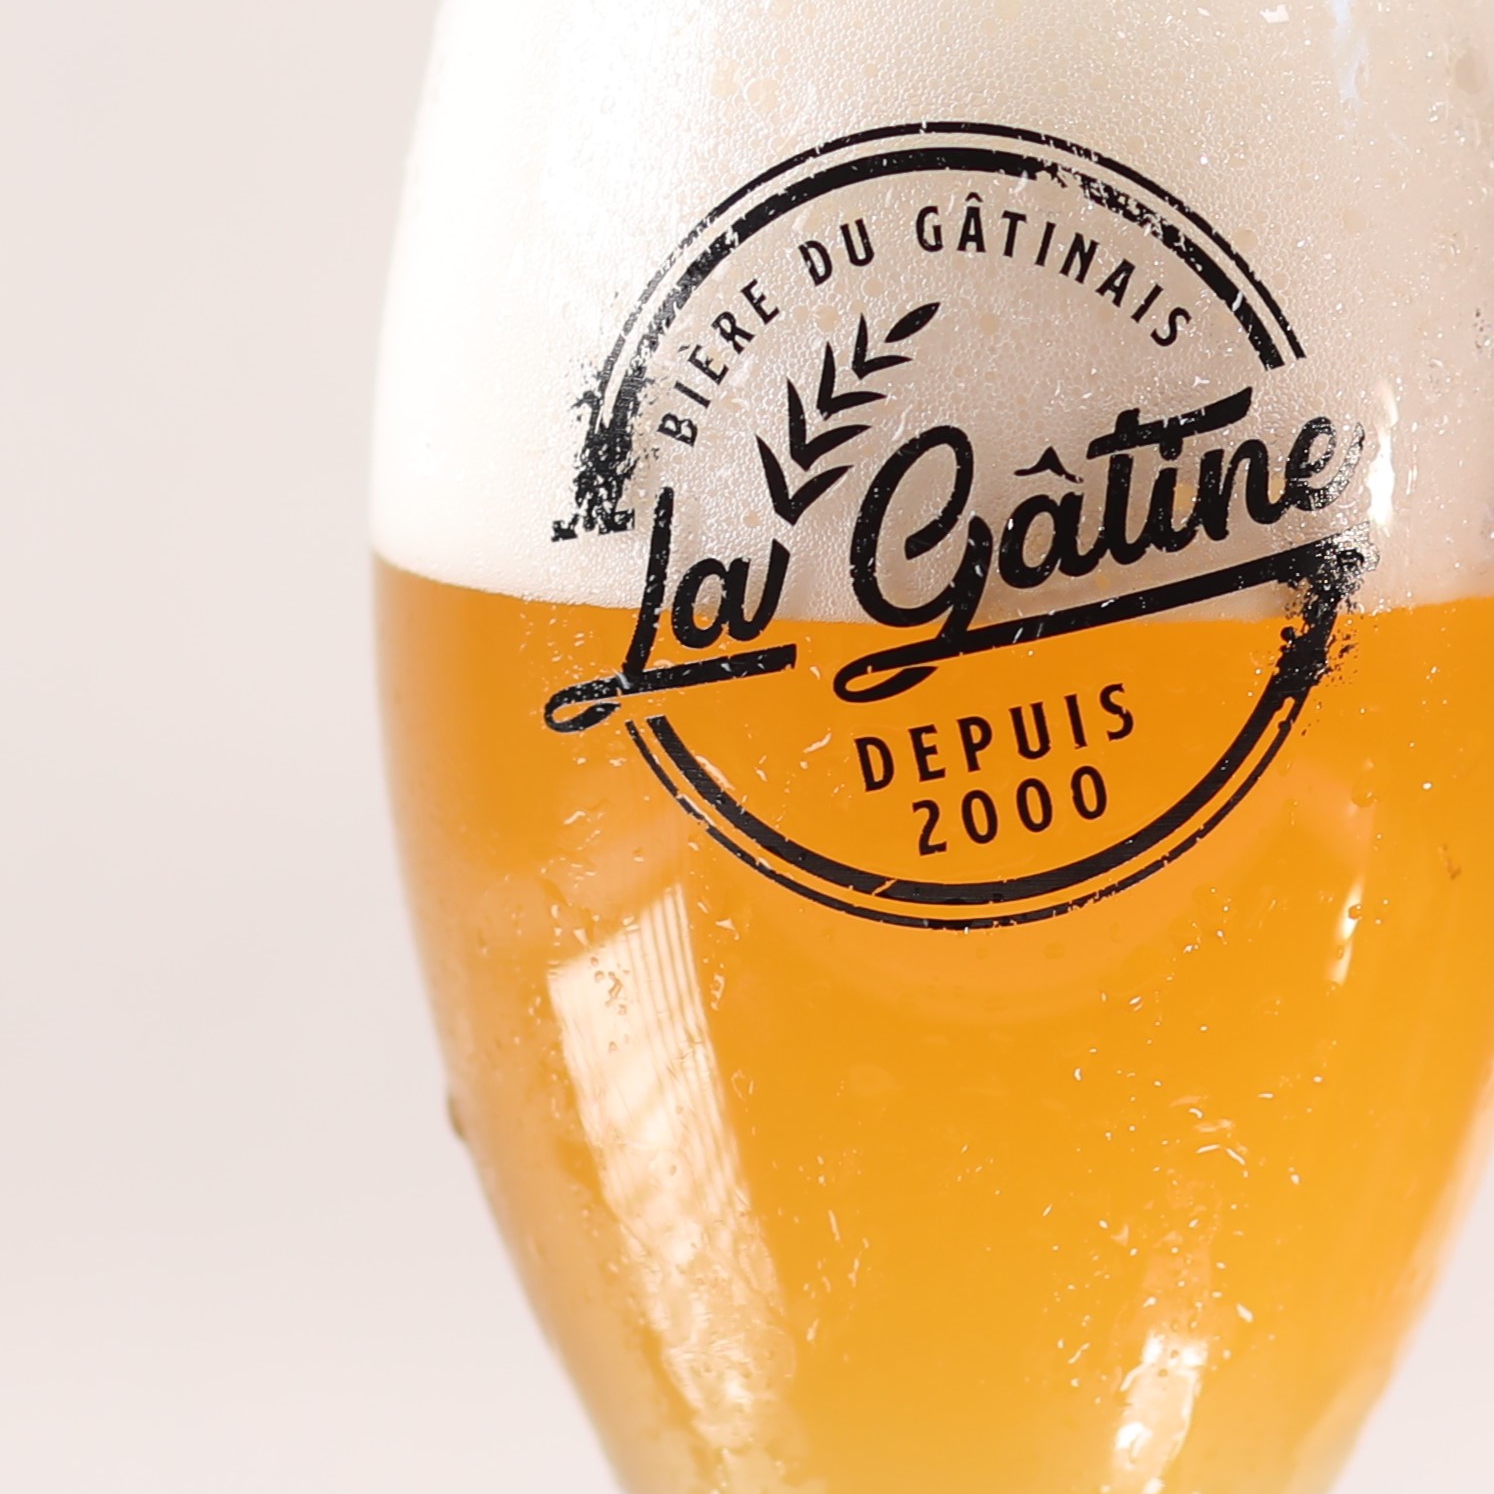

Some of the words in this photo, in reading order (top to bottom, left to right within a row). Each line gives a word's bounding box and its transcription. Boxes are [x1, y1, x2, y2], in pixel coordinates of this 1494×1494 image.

[657, 279, 780, 447] BIÈRE
[799, 218, 876, 287] DU
[916, 193, 1192, 347] GÂTINAIS
[544, 486, 797, 733] La
[833, 387, 1372, 704] Gâtine
[854, 683, 1136, 793] DEPUIS
[911, 765, 1108, 857] 2000
